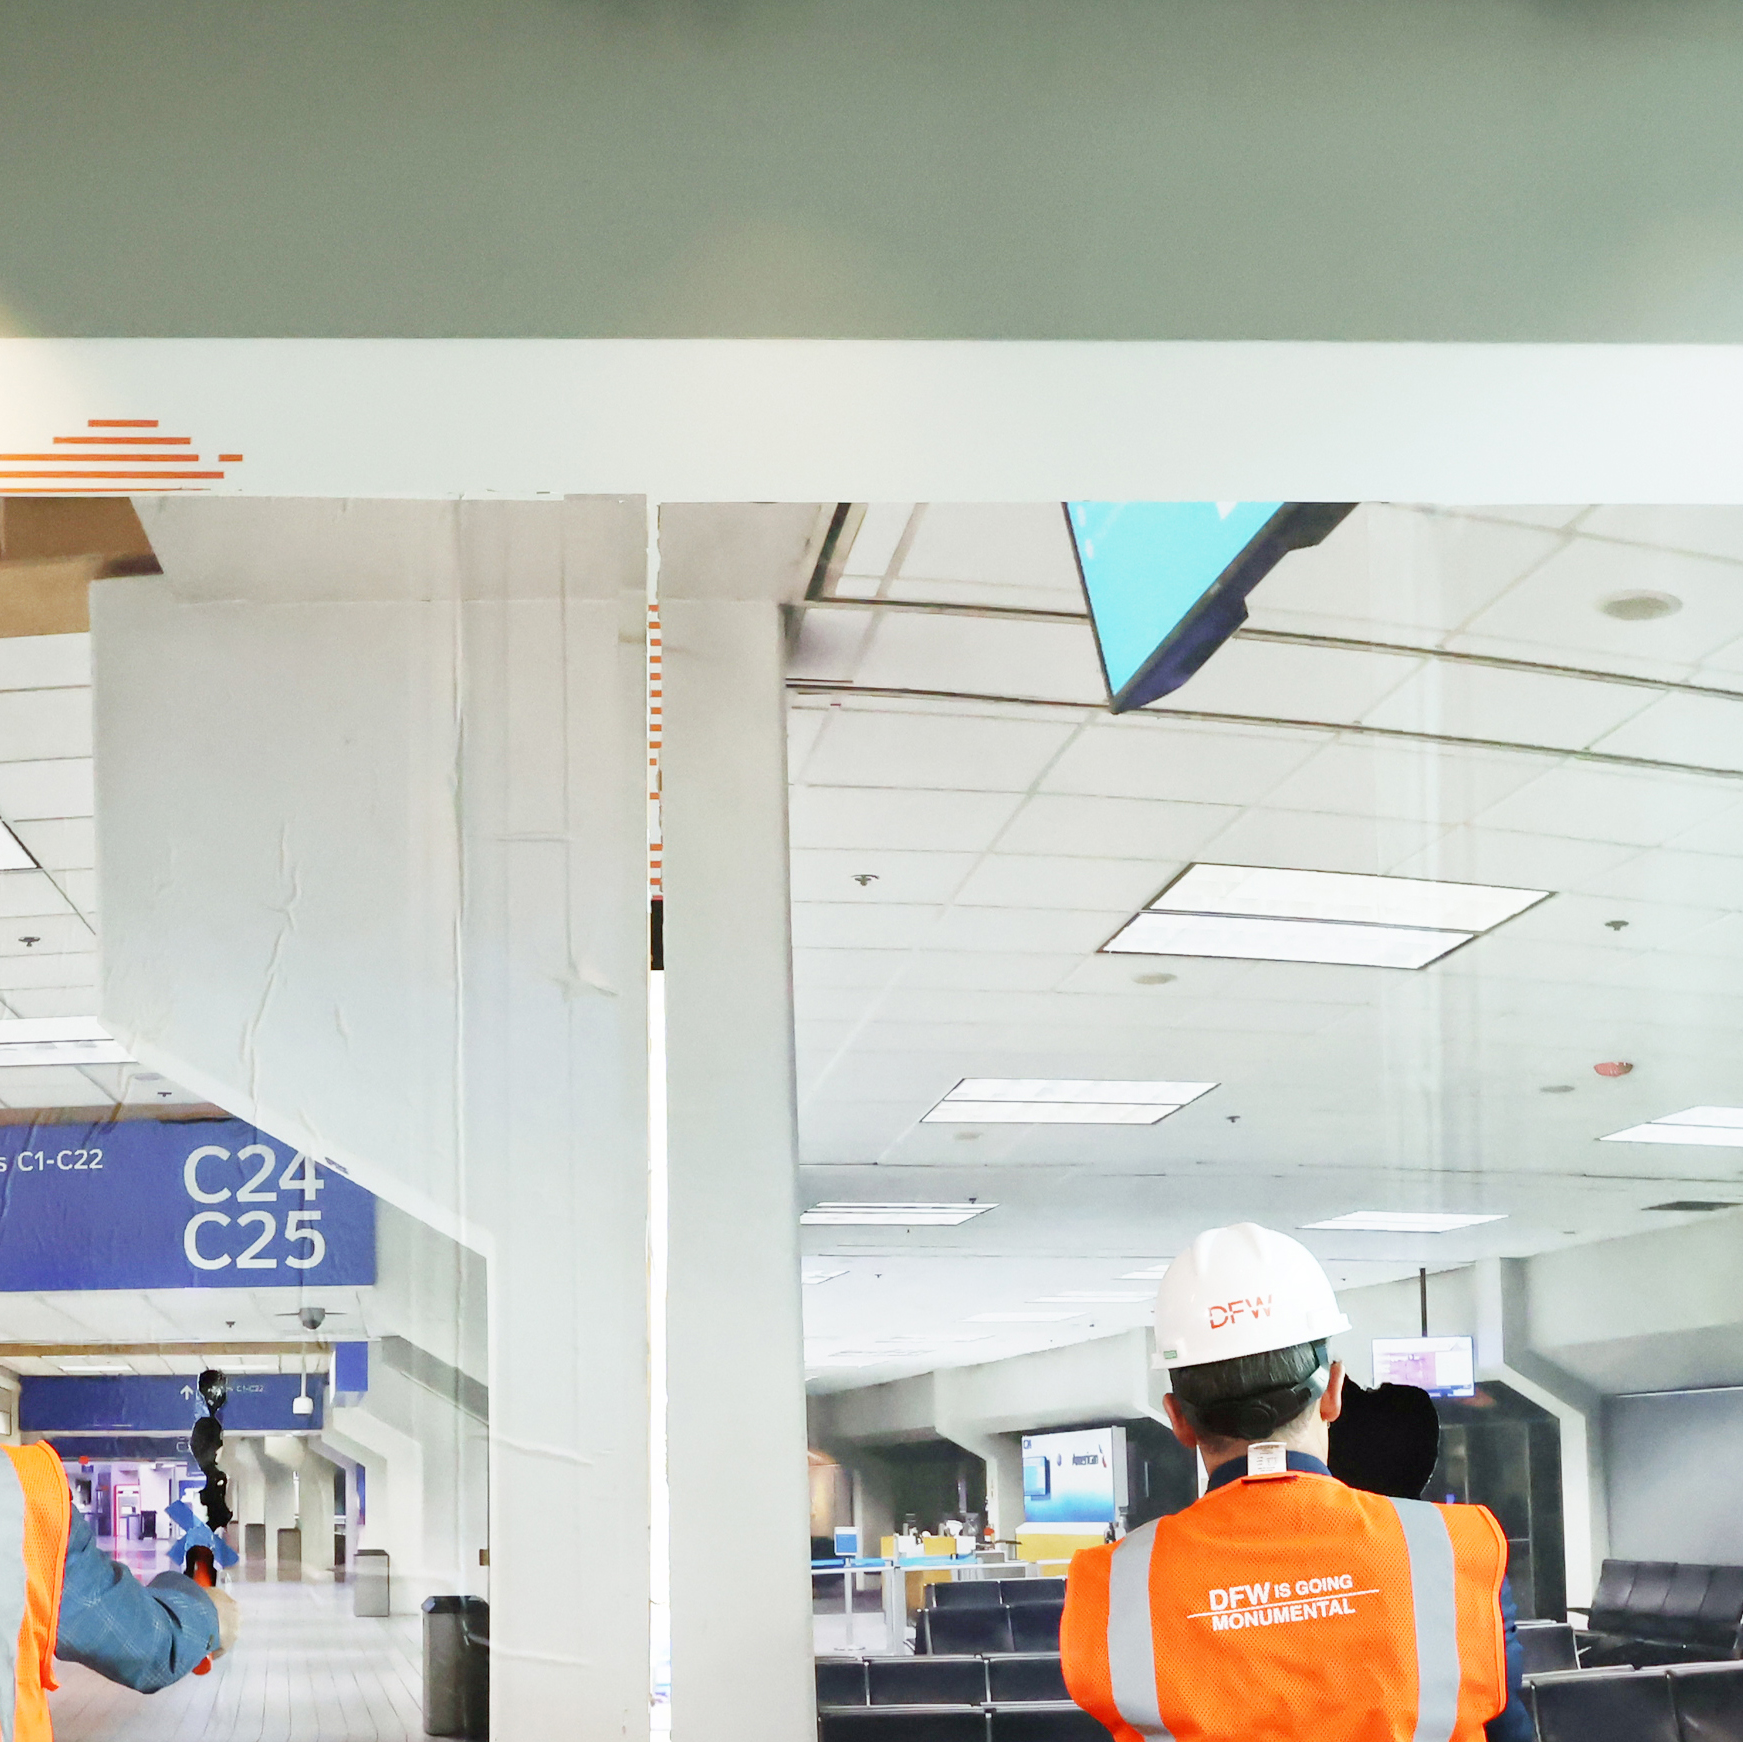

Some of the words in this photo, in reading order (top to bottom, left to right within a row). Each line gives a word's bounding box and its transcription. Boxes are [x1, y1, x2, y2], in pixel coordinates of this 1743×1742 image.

[17, 1148, 104, 1172] C1-C22
[183, 1144, 325, 1203] C24
[183, 1210, 326, 1270] C25
[1208, 1294, 1272, 1330] DFW
[1209, 1581, 1270, 1611] DFW
[1274, 1584, 1291, 1599] IS
[1295, 1574, 1354, 1596] GOING
[1212, 1598, 1356, 1632] MONUMENTAL
